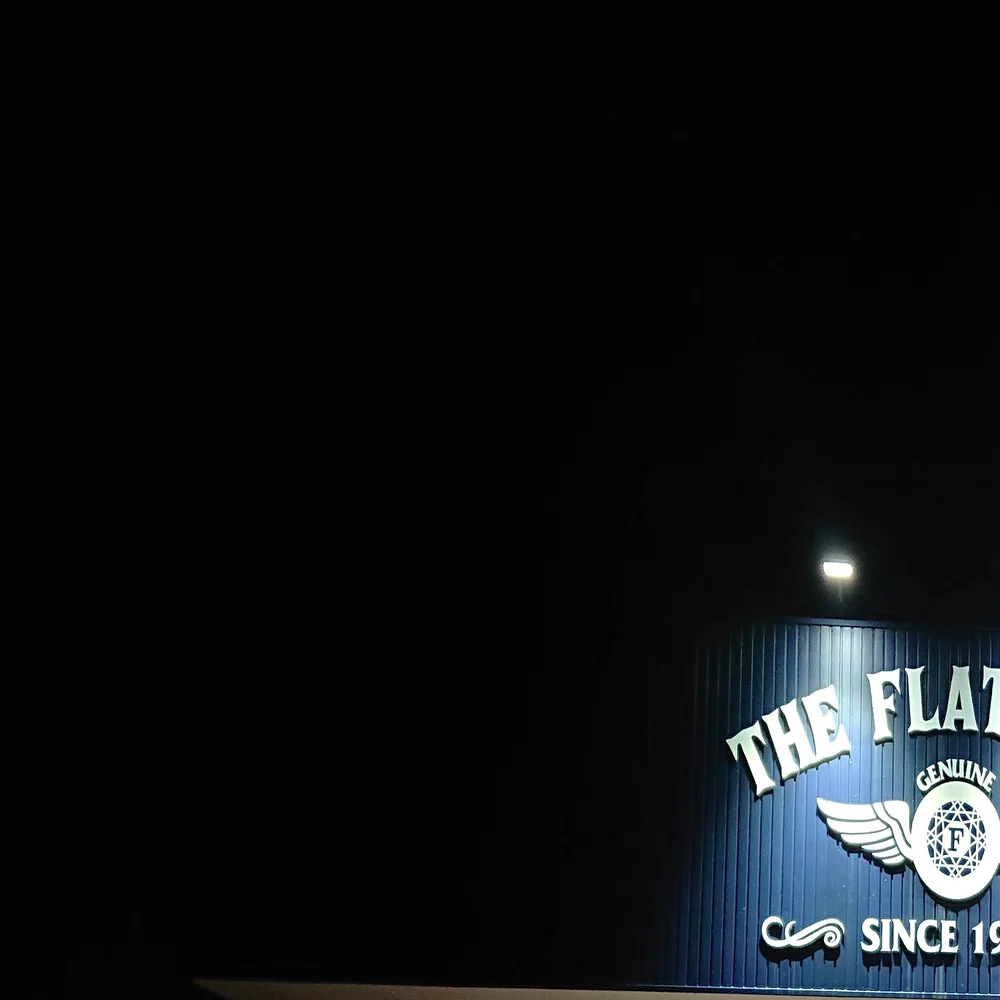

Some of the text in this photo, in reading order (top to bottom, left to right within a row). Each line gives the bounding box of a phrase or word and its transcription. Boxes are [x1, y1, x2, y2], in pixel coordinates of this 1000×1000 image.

[726, 684, 851, 797] THE
[916, 758, 997, 793] GENUINE
[948, 827, 964, 851] F
[861, 918, 959, 956] SINCE
